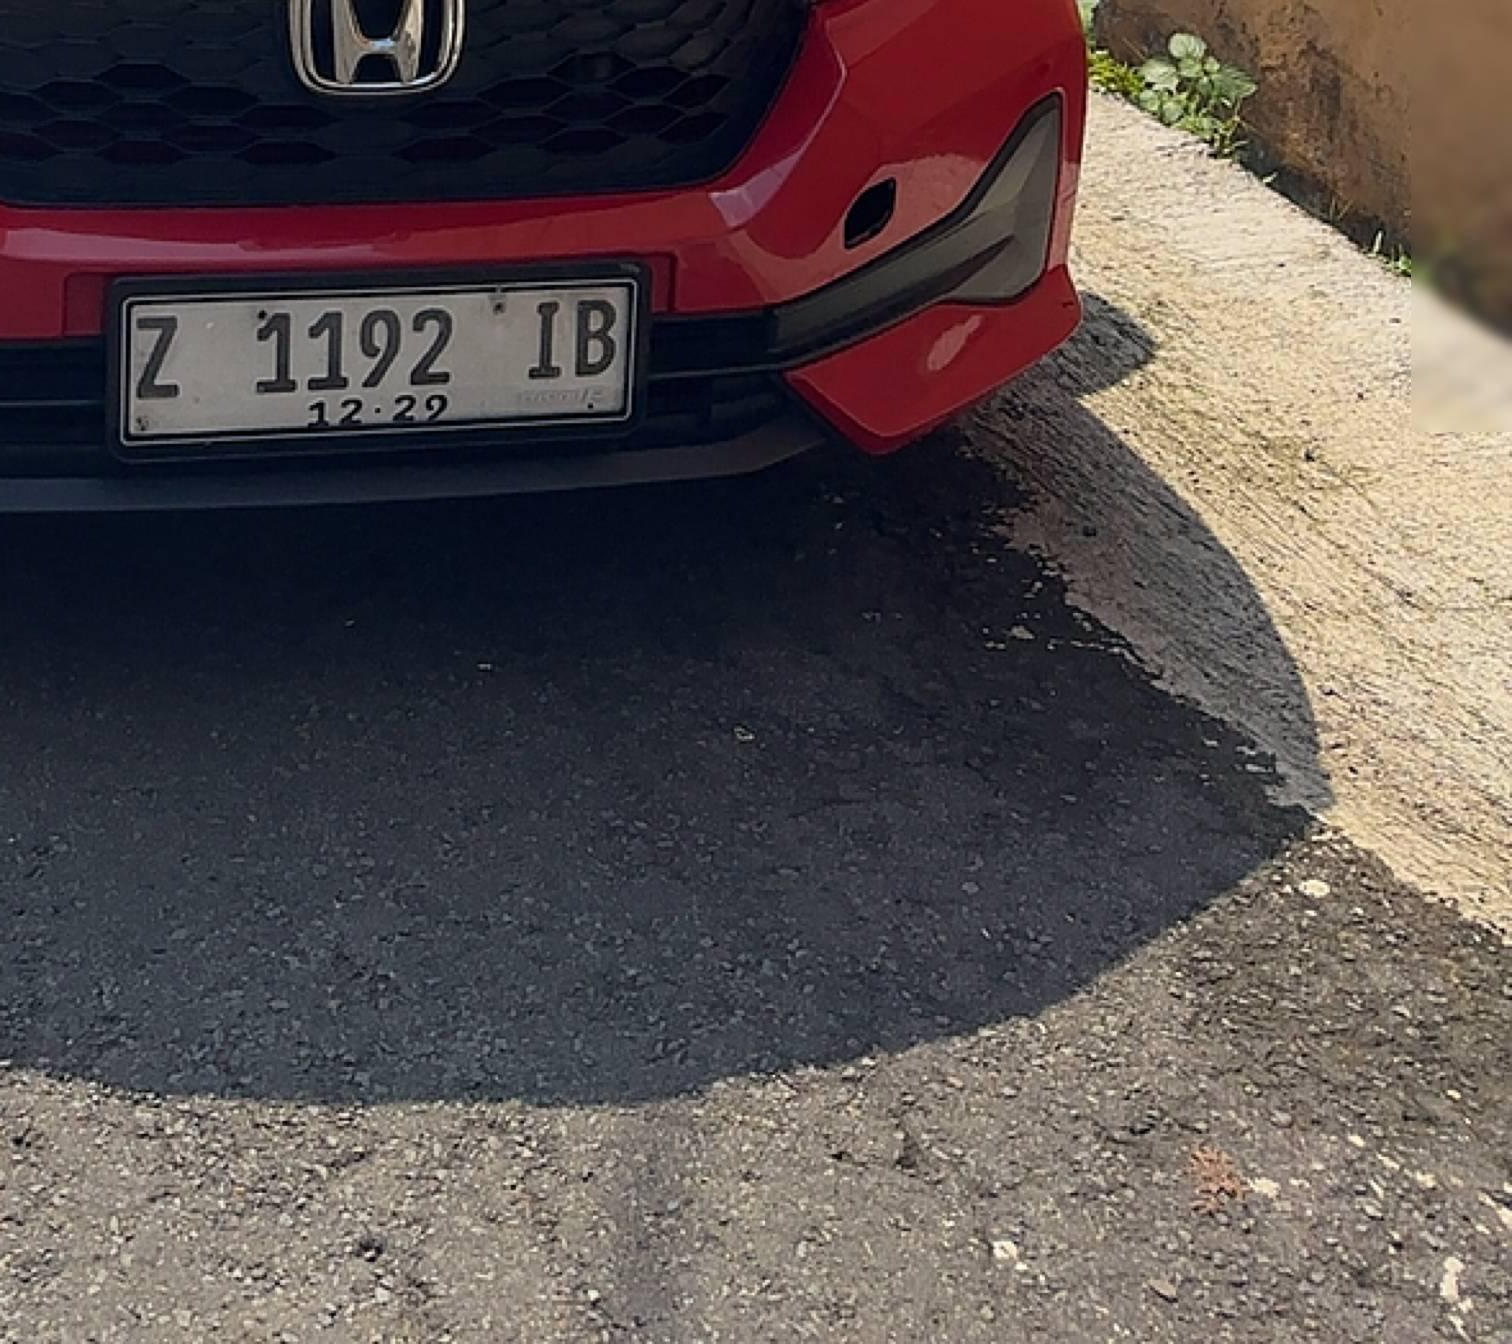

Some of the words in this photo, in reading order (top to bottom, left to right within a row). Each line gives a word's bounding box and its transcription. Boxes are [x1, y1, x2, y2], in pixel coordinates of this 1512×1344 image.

[136, 317, 178, 399] Z
[256, 308, 453, 393] 1192
[528, 298, 618, 380] IB
